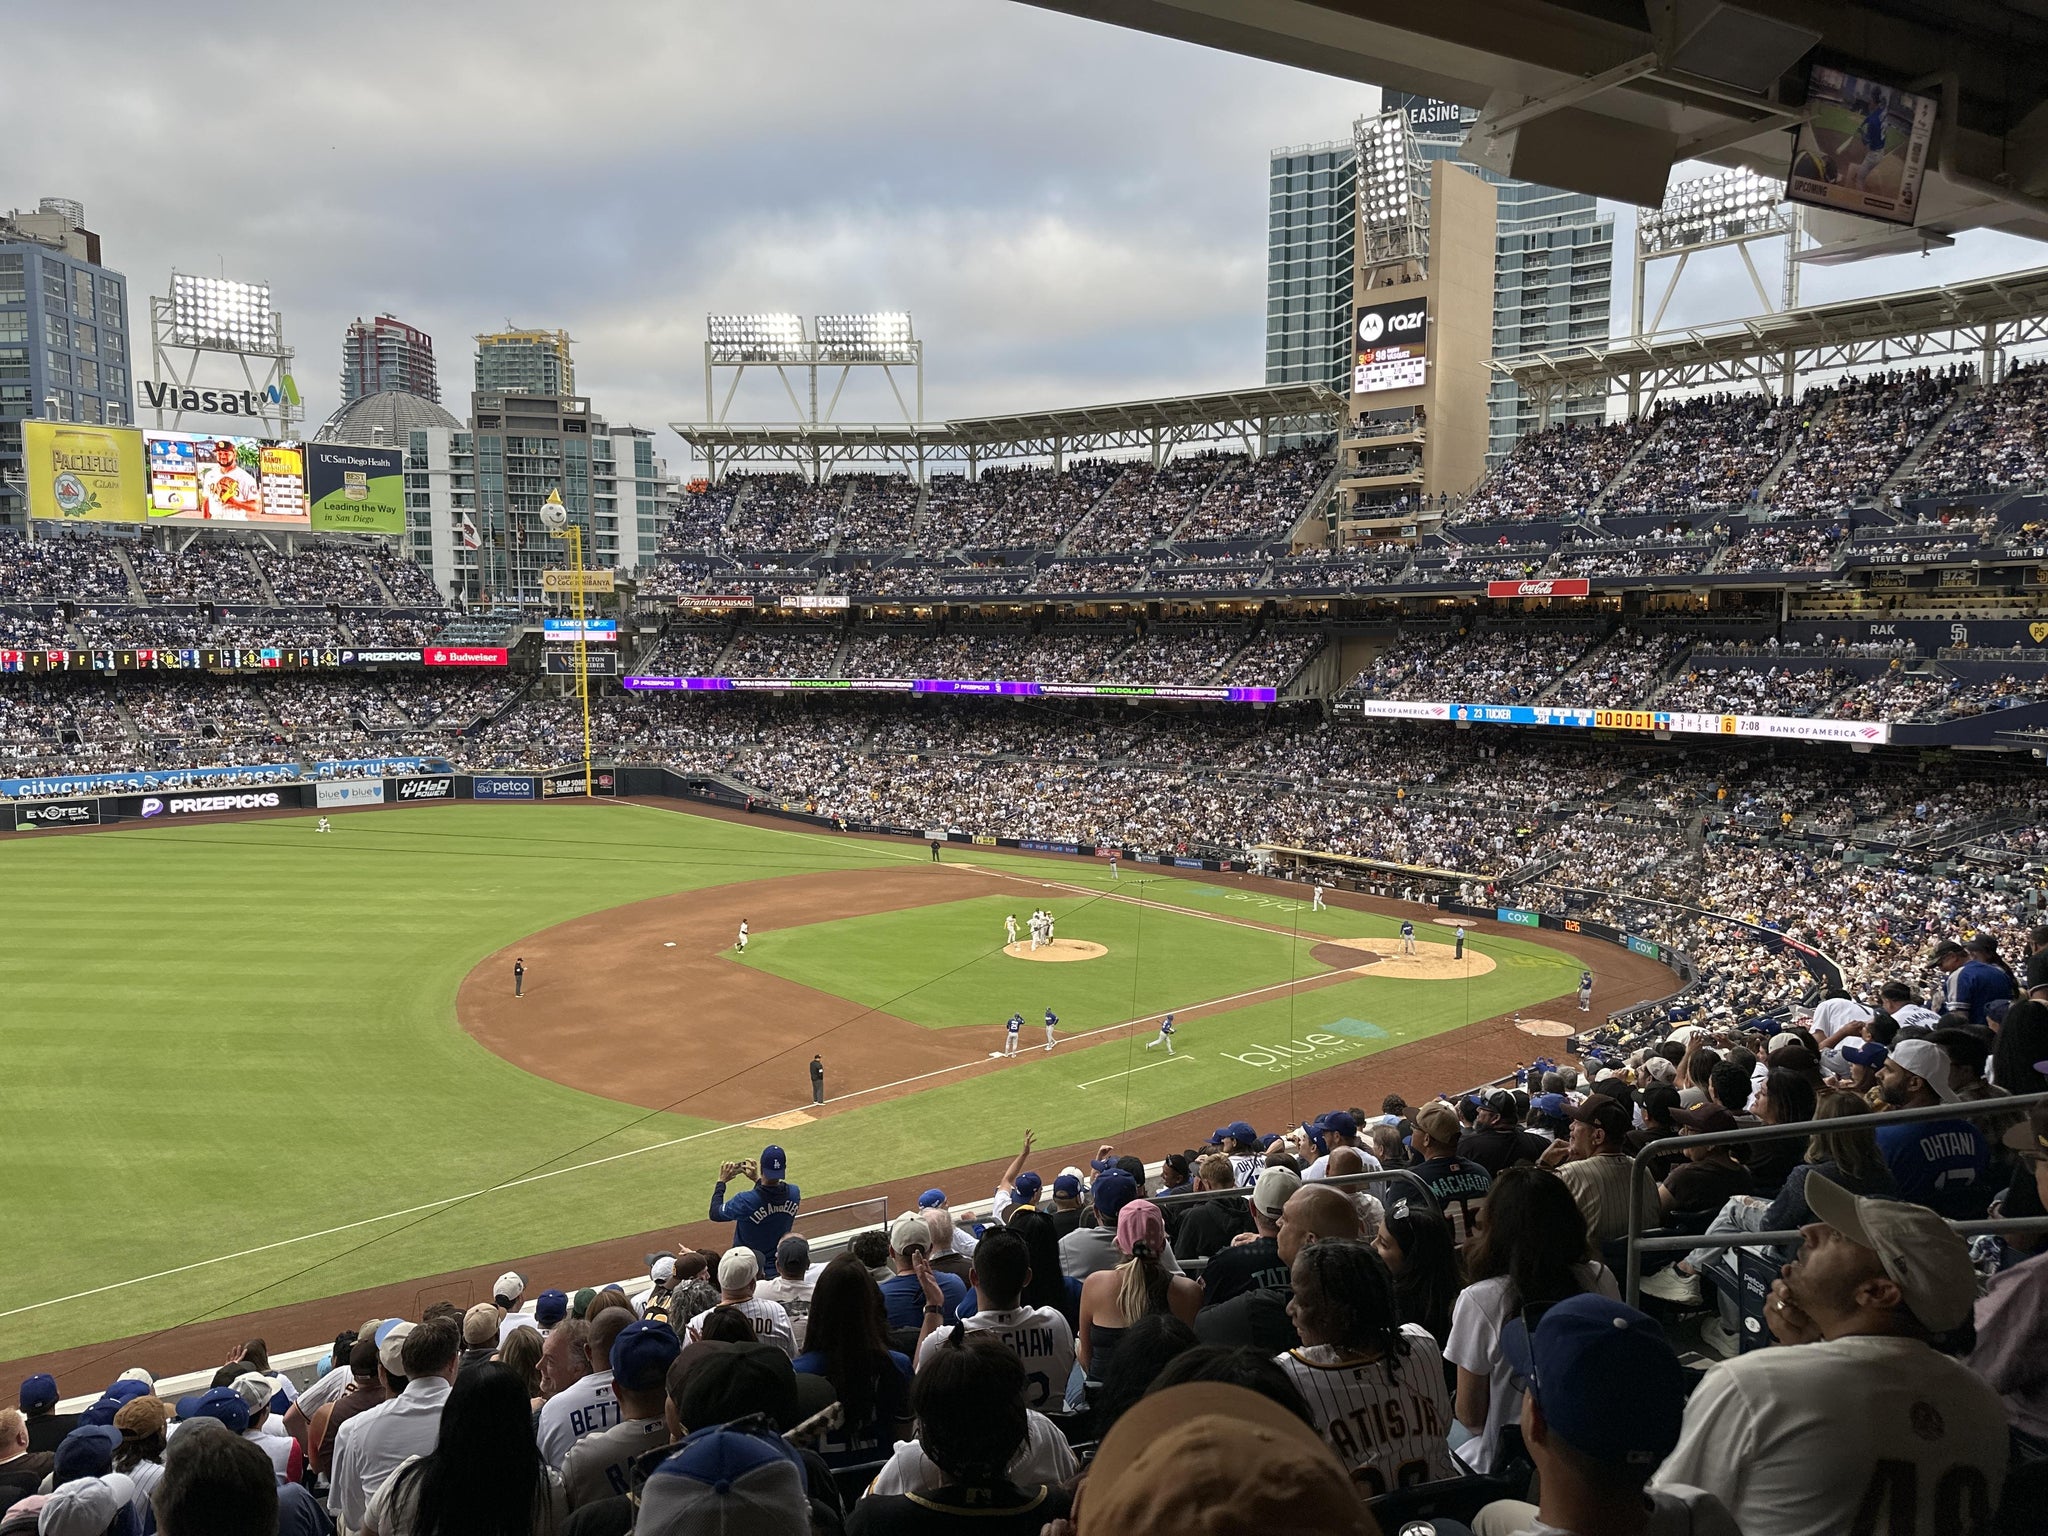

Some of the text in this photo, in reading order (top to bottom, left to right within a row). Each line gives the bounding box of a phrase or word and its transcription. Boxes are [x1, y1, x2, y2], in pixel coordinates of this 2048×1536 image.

[1411, 105, 1459, 123] EASING
[1794, 179, 1828, 197] UPCOMING
[1388, 311, 1425, 333] razr
[144, 380, 257, 416] Viasat
[320, 454, 391, 467] UC San Diego Health
[324, 502, 396, 514] Leading the Way
[368, 514, 389, 523] Diego
[1869, 553, 1949, 563] STEVE 6 GARVEY
[2006, 547, 2044, 557] TONY 19
[679, 597, 719, 606] Tarantino
[1870, 624, 1895, 635] RAK
[2034, 627, 2044, 637] PS
[33, 656, 39, 666] F
[63, 651, 69, 660] 9
[79, 655, 85, 665] F
[108, 651, 114, 660] 2
[123, 655, 130, 664] F
[151, 651, 158, 659] 4
[208, 655, 214, 663] F
[288, 653, 294, 662] F
[358, 652, 421, 661] PRIZEPICKS
[450, 653, 498, 662] Budweiser
[17, 662, 24, 671] 6
[63, 662, 69, 670] 7
[108, 661, 115, 670] 4
[152, 660, 158, 669] 3
[194, 660, 200, 668] 2
[1474, 709, 1511, 719] 23 TUCKER
[1605, 712, 1612, 726] 0
[1625, 713, 1632, 727] 0
[1646, 714, 1651, 728] 1
[1726, 722, 1731, 732] 6
[1741, 721, 1760, 731] 7:08
[1770, 725, 1795, 733] BANK
[1812, 729, 1856, 737] AMERICA
[417, 780, 450, 792] H2O
[493, 783, 530, 793] petco
[319, 788, 372, 799] blue blue
[170, 793, 280, 814] PRIZEPICKS
[26, 806, 89, 820] EVOTEK
[1508, 912, 1529, 923] COX
[1635, 941, 1652, 954] COX
[1221, 1033, 1344, 1067] blue
[1269, 1041, 1365, 1073] CALIFORNIA
[1920, 1132, 1975, 1162] OHTANI
[1432, 1174, 1491, 1199] MACHADO
[750, 1207, 769, 1225] LOS
[1744, 1273, 1766, 1291] petco
[1747, 1283, 1764, 1298] park
